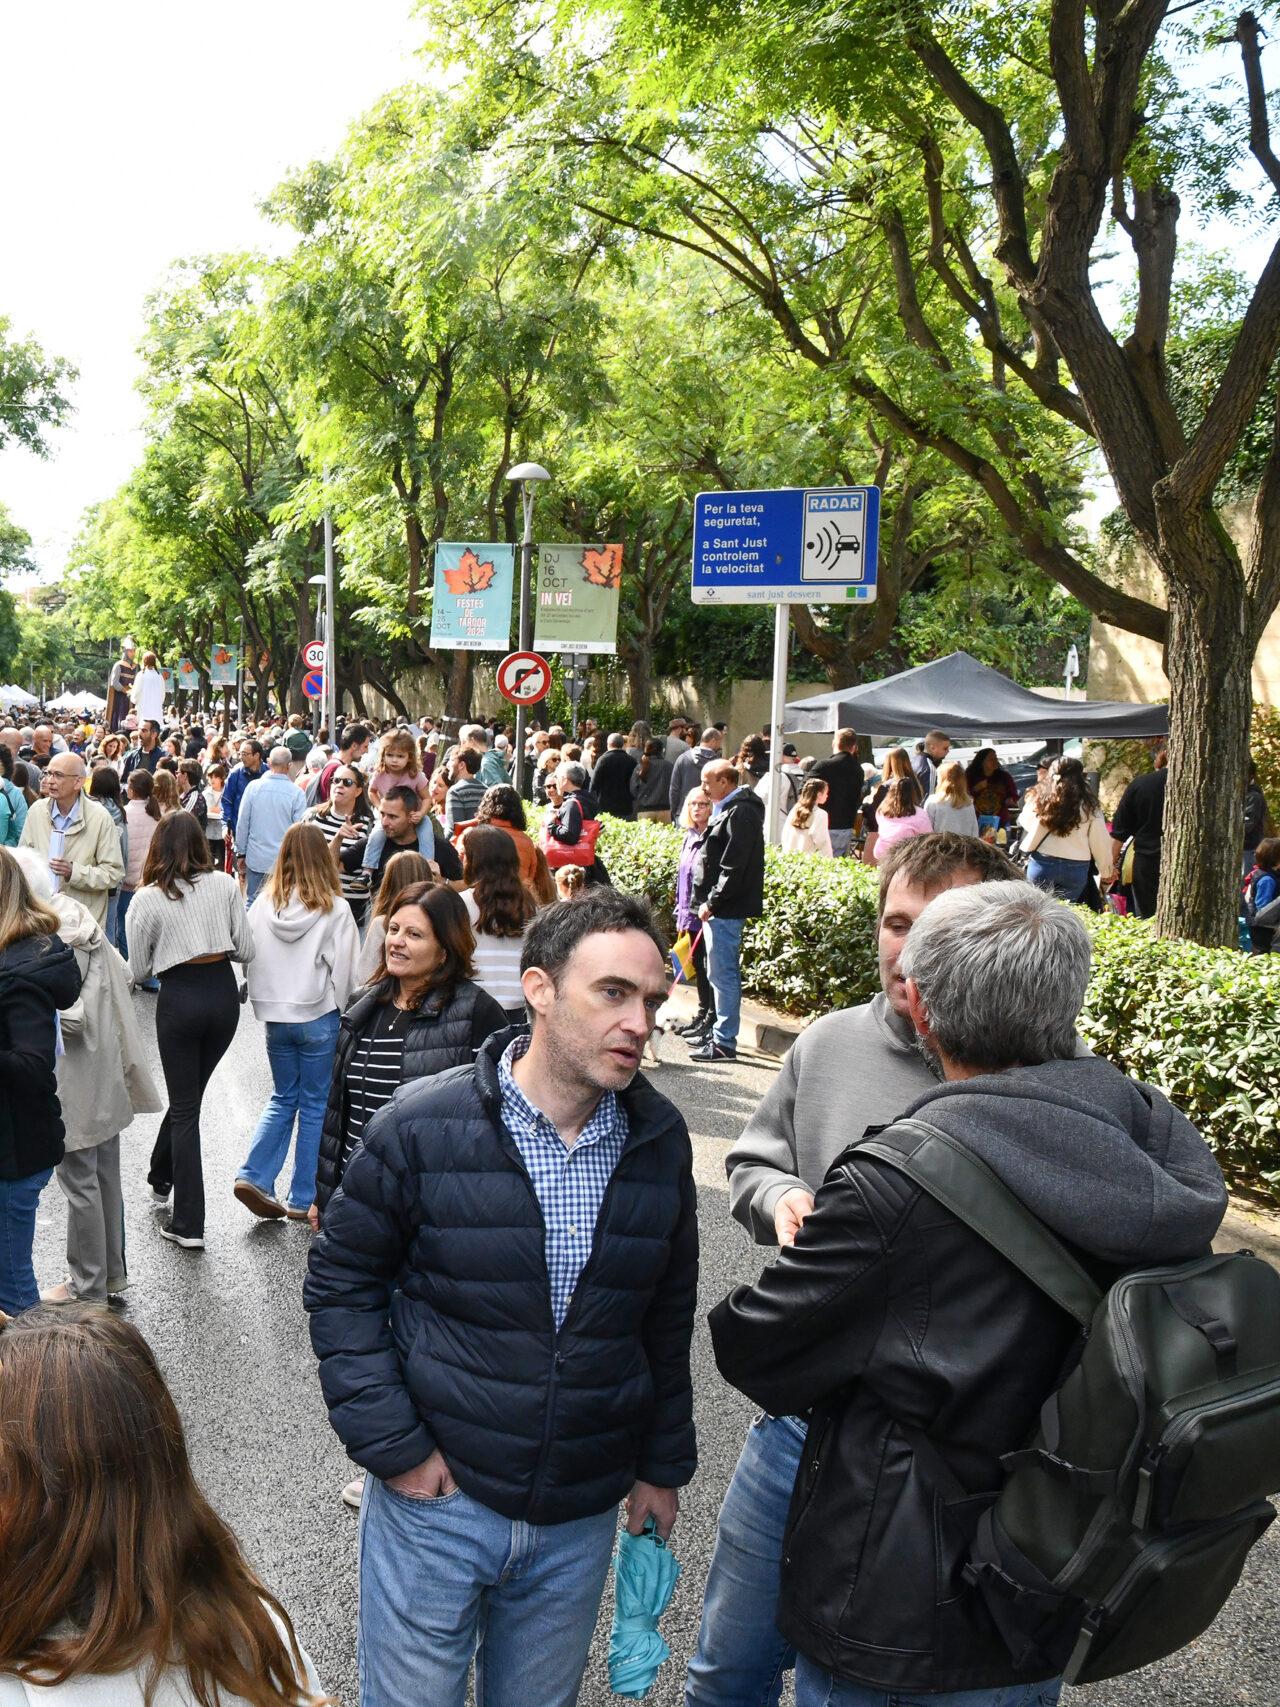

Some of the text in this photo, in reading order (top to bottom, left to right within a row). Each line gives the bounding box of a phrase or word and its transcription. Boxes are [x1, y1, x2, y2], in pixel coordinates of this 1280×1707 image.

[704, 503, 764, 514] Per la teva
[809, 497, 860, 510] RADAR
[704, 516, 761, 528] seguretat,
[713, 538, 740, 548] Sant
[742, 537, 768, 548] Just
[544, 553, 560, 563] DJ
[702, 551, 759, 561] controlem
[544, 566, 555, 575] 16
[702, 563, 764, 574] la velocitat
[542, 577, 568, 588] OCT
[540, 591, 552, 606] IN
[746, 590, 821, 600] sant just desvern
[456, 598, 484, 608] FESTES
[464, 608, 474, 617] DE
[466, 627, 485, 637] 2025
[309, 650, 324, 661] 30
